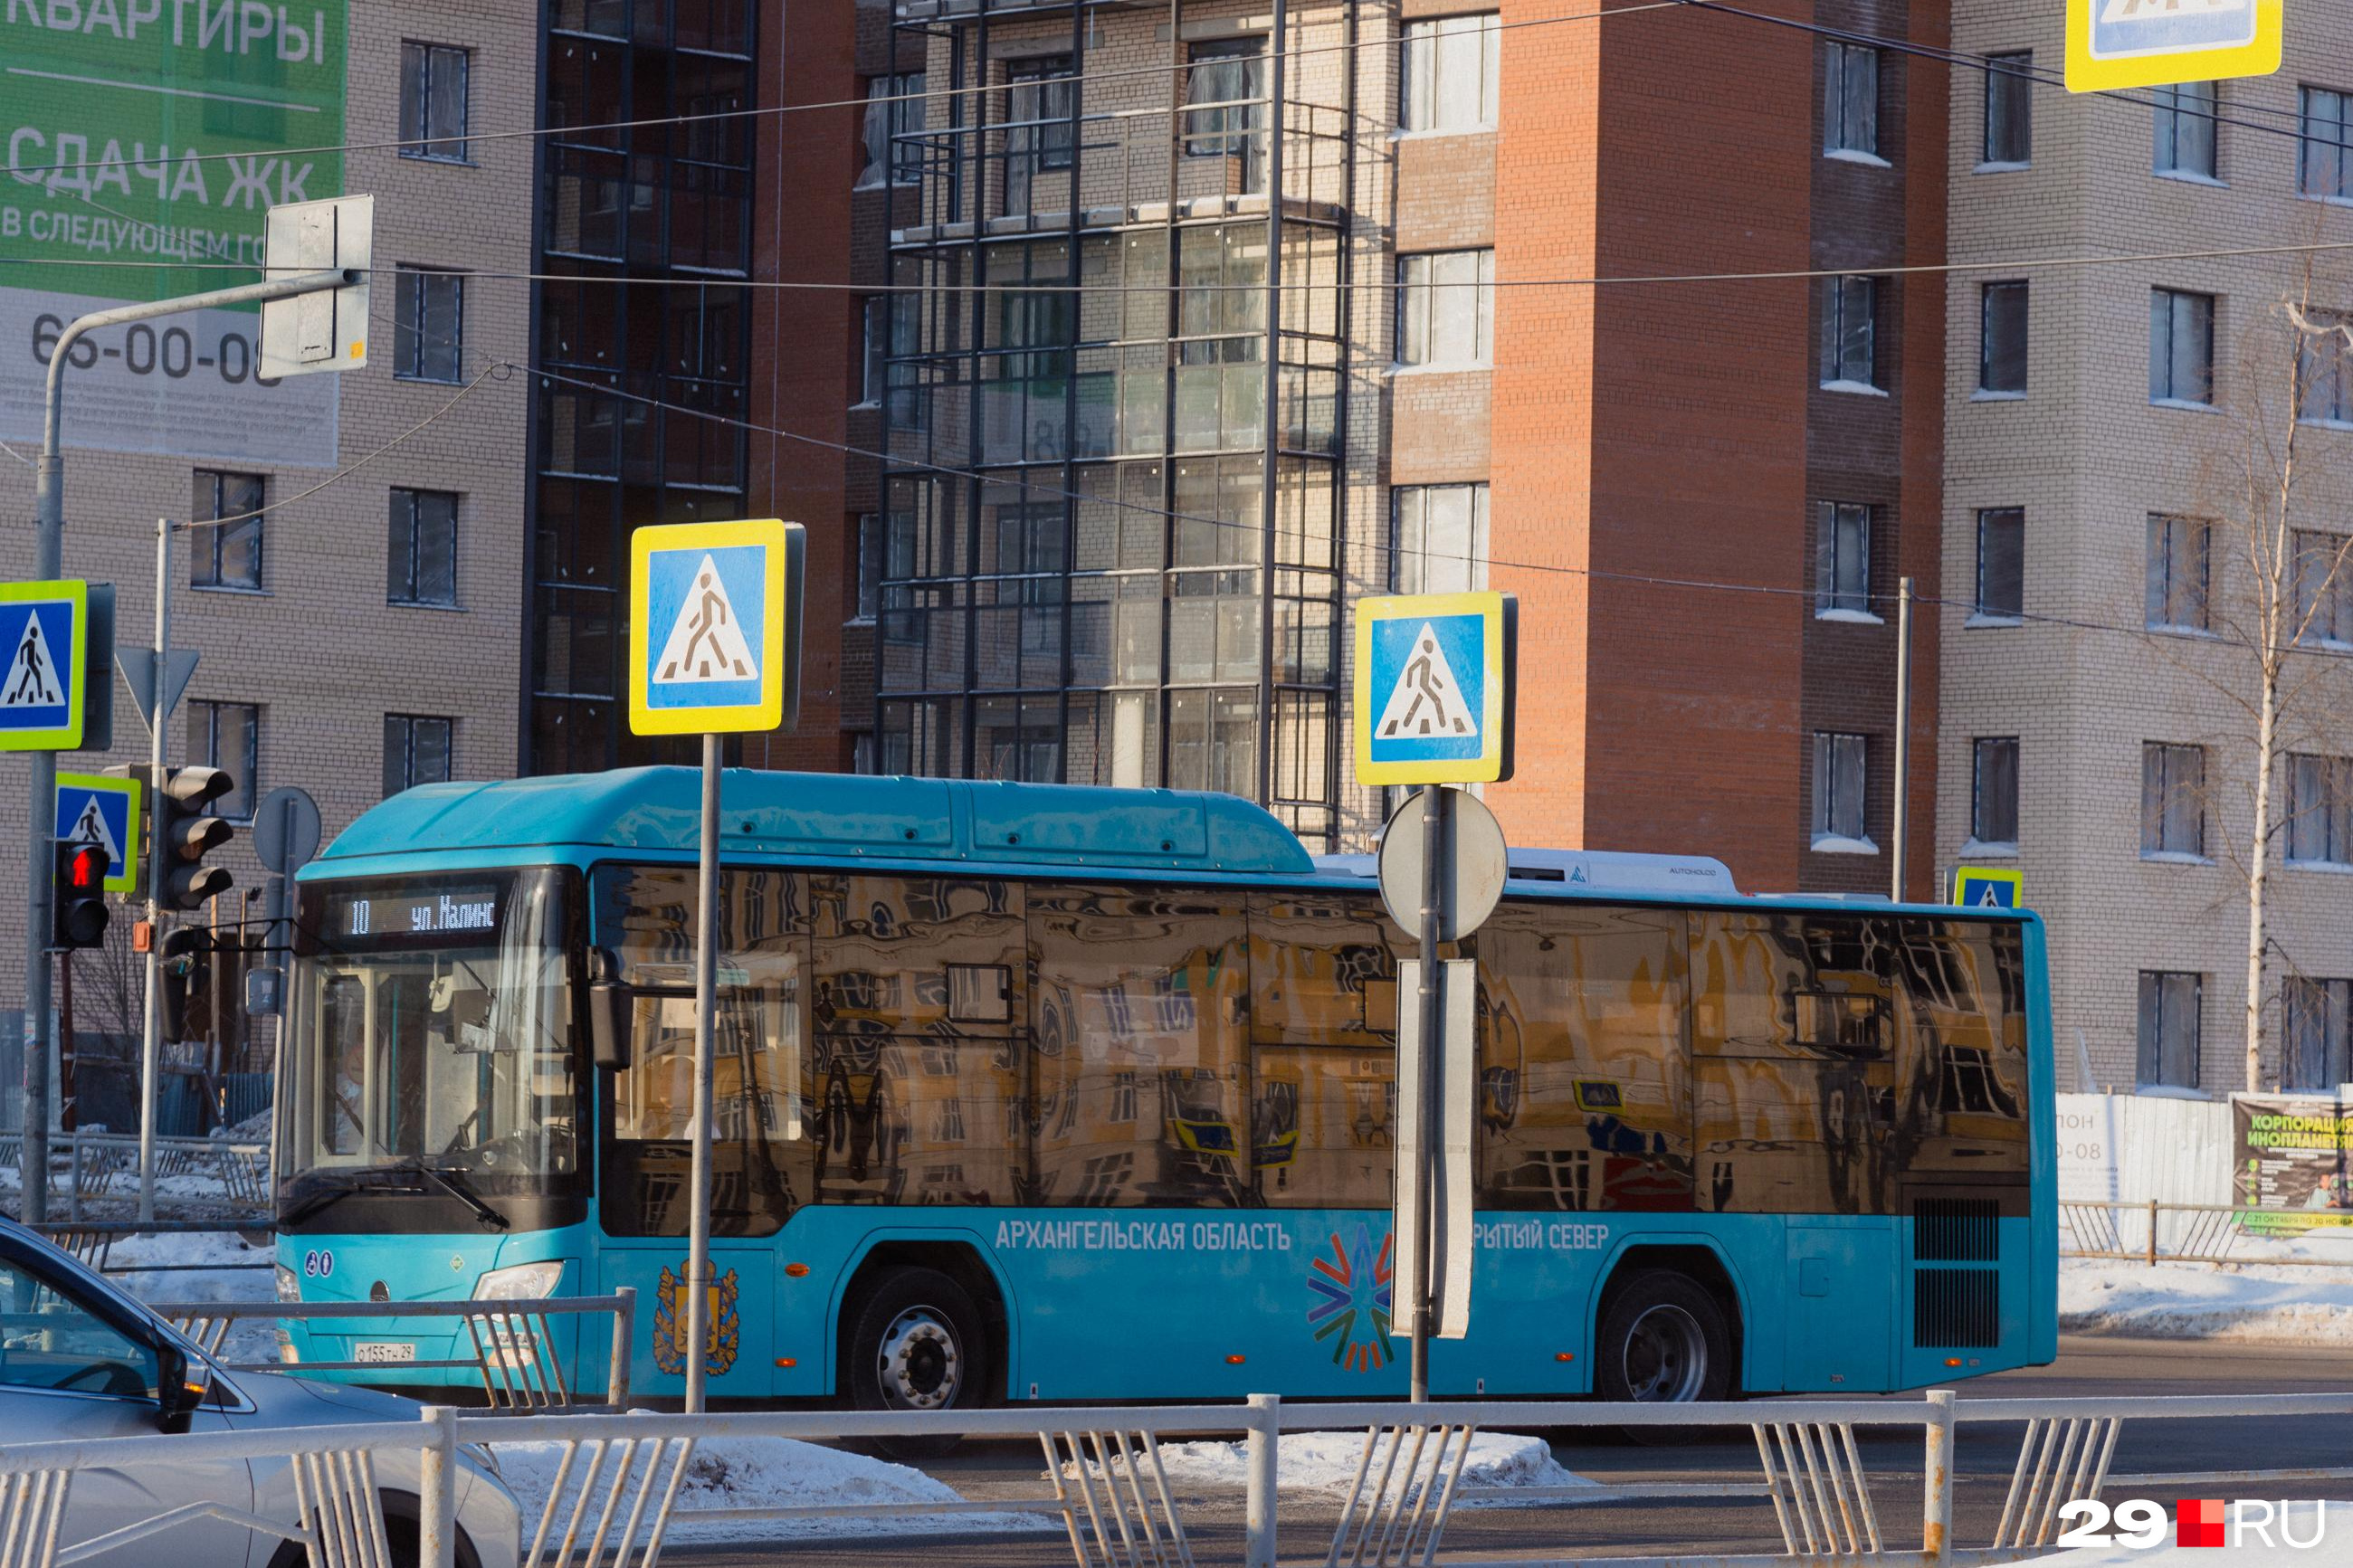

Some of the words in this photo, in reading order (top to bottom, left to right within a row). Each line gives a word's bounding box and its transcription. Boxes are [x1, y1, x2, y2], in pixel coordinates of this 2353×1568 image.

[9, 127, 209, 201] СДАЧА
[222, 154, 314, 210] ЖК
[2, 206, 22, 237] В
[29, 210, 228, 262] СЛЕДУЮЩЕМ
[351, 900, 370, 935] 10
[2251, 1113, 2353, 1134] КОРПОРАЦИЯ
[996, 1221, 1186, 1250] АРХАНГЕЛЬСКАЯ
[1192, 1222, 1291, 1250] ОБЛАСТЬ
[1473, 1219, 1542, 1249] РЫТЫЙ
[1548, 1224, 1609, 1250] СЕВЕР
